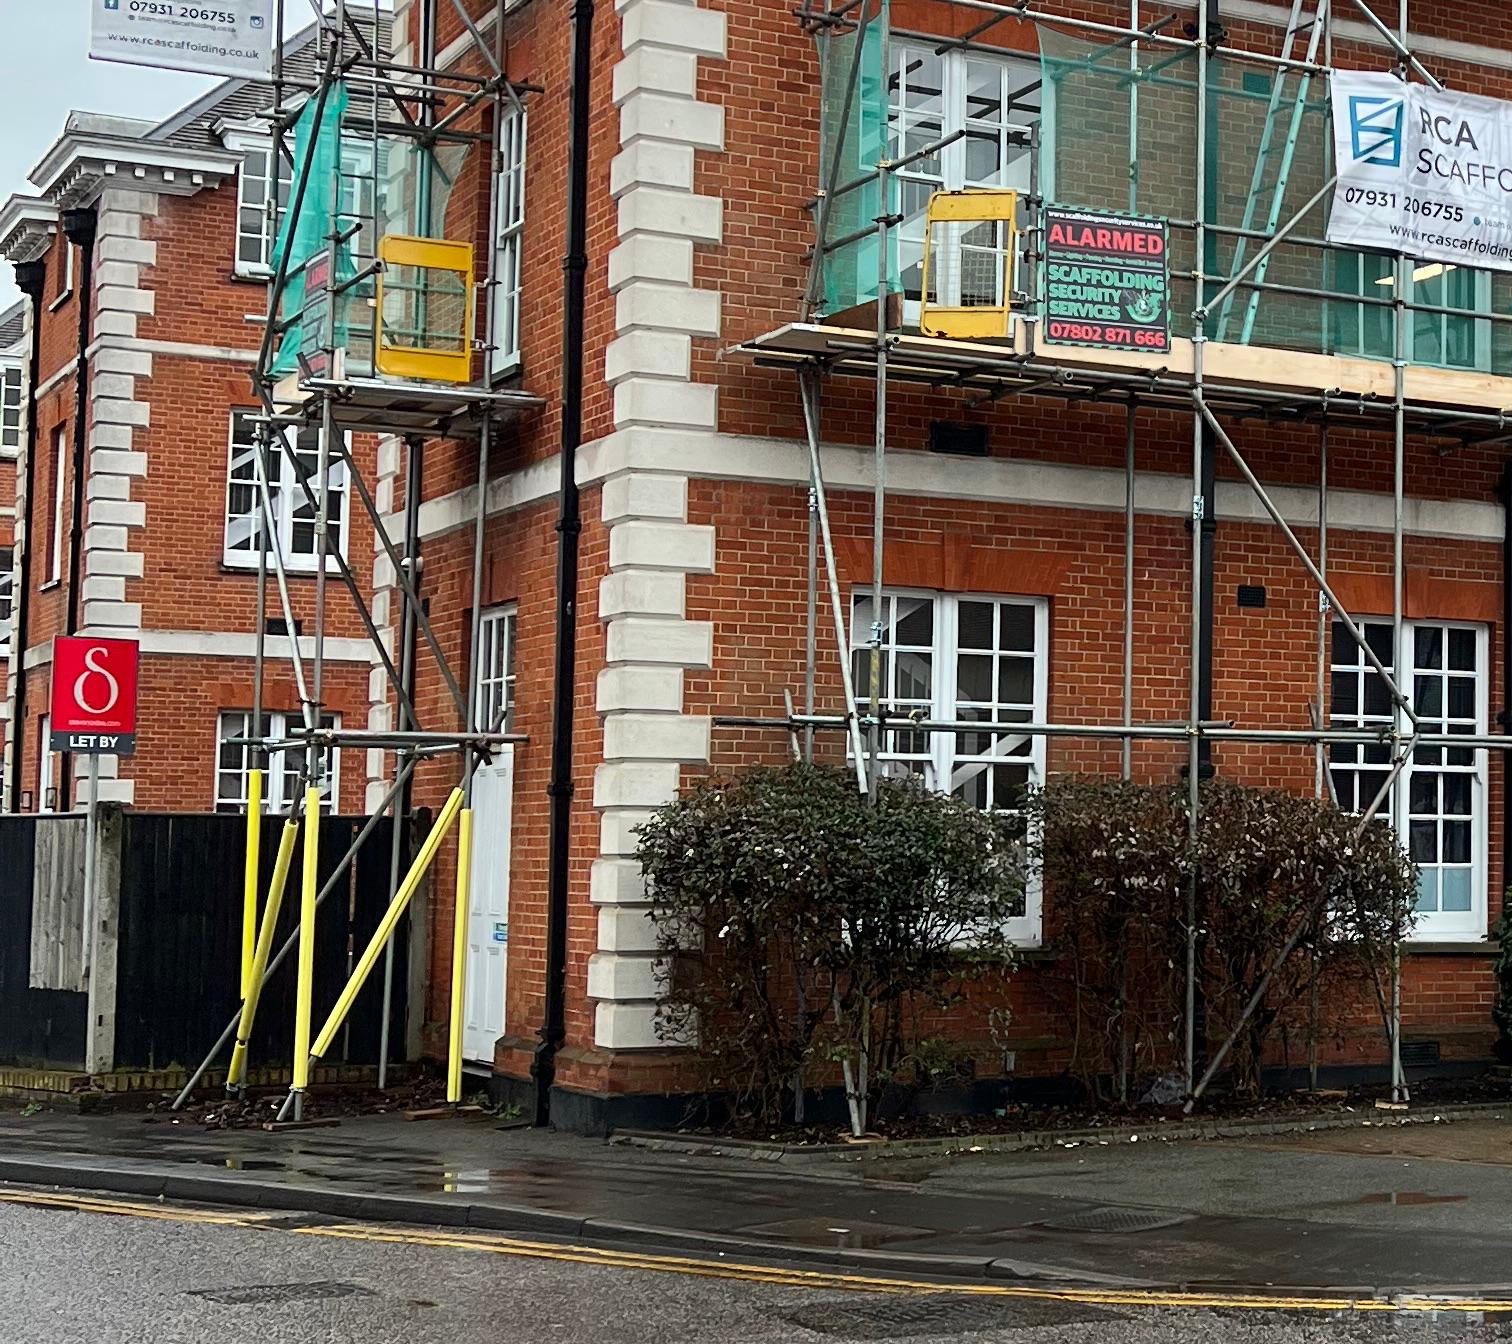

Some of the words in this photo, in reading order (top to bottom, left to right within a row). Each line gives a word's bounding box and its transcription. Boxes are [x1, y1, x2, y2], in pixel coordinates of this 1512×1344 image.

[129, 0, 173, 16] 07931
[180, 7, 236, 24] 206755
[108, 32, 259, 59] www.rcascaffolding.co.uk
[1419, 106, 1479, 151] RCA
[1345, 187, 1397, 209] 07931
[1403, 196, 1464, 223] 206755
[1048, 223, 1164, 255] ALARMED
[1047, 264, 1165, 291] SCAFFOLDING
[1049, 283, 1121, 304] SECURITY
[1049, 300, 1120, 321] SERVICES
[1049, 322, 1102, 341] 07802
[1105, 327, 1131, 343] 871
[1134, 330, 1166, 347] 666
[69, 735, 97, 748] LET
[99, 736, 119, 748] BY
